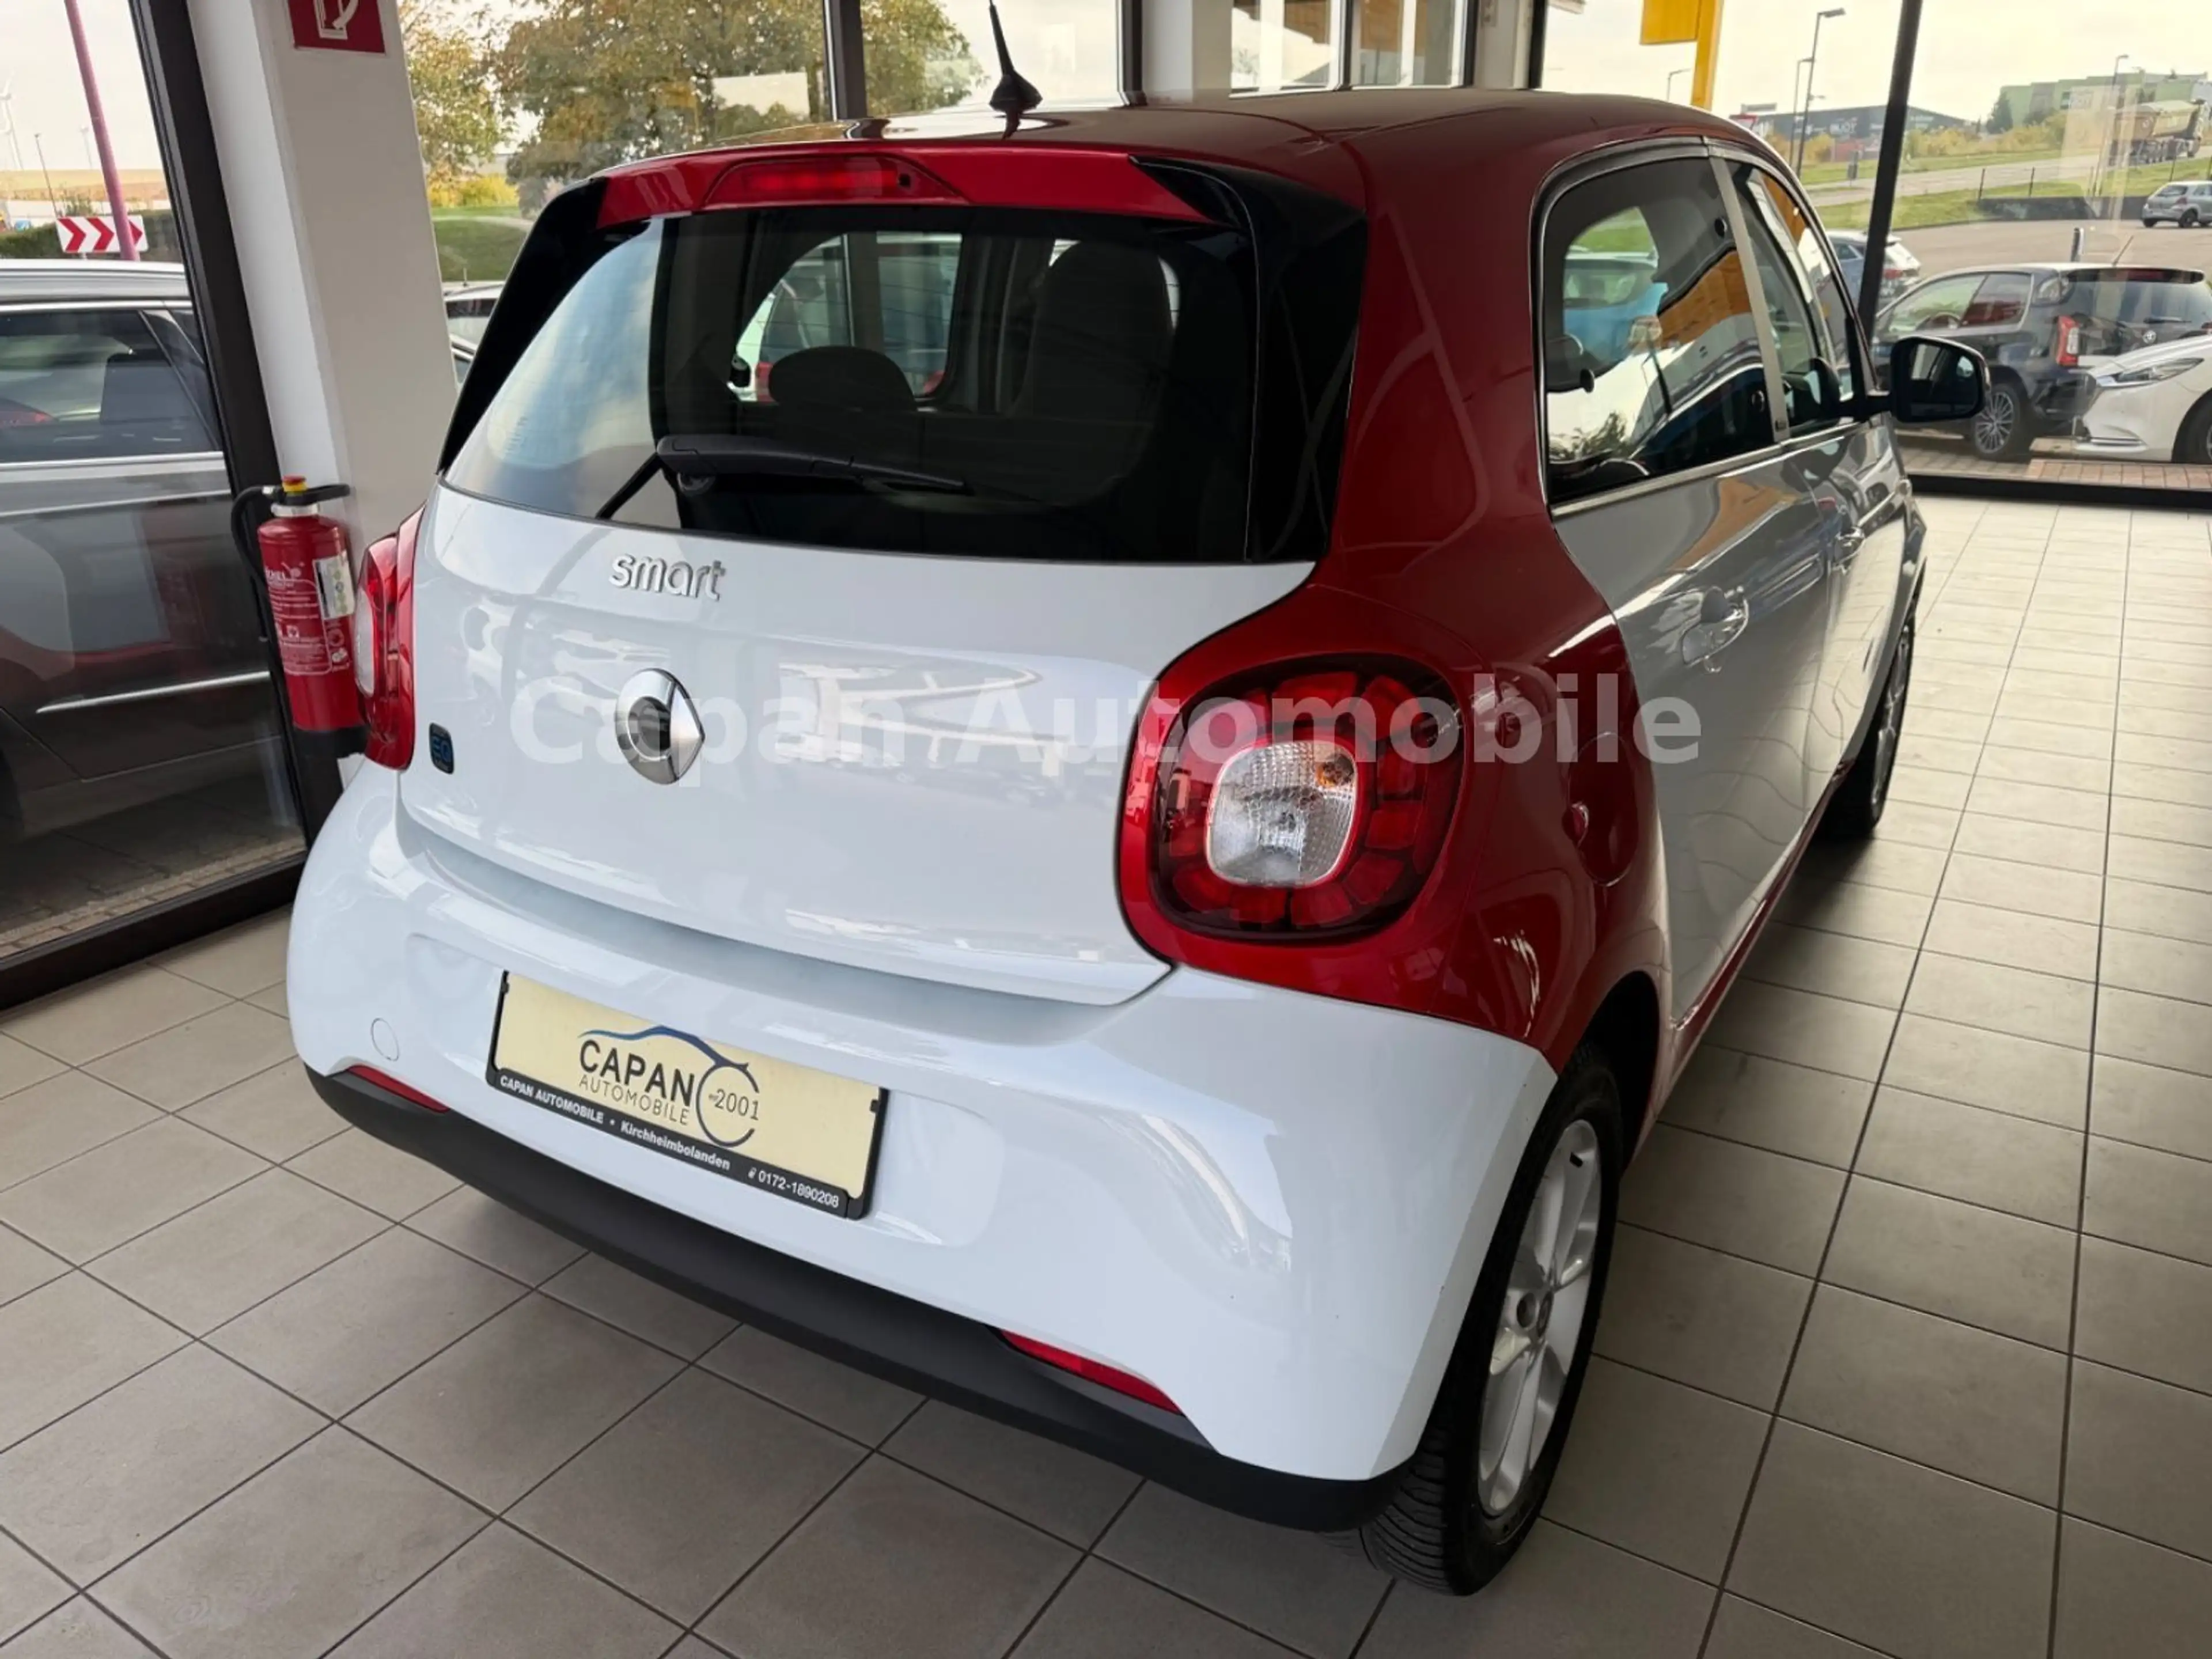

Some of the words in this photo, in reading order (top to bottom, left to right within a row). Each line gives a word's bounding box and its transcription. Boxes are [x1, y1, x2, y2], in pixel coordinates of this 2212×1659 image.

[608, 553, 726, 601] smart
[579, 1039, 695, 1107] CAPAN
[579, 1074, 690, 1125] AUTOMOBILE
[715, 1088, 759, 1120] 2001
[500, 1075, 534, 1097] CAPAN
[535, 1089, 604, 1124] AUTOMOBILE
[620, 1120, 730, 1171] Kirchheimbolanden
[758, 1170, 839, 1208] 0172-1890208
